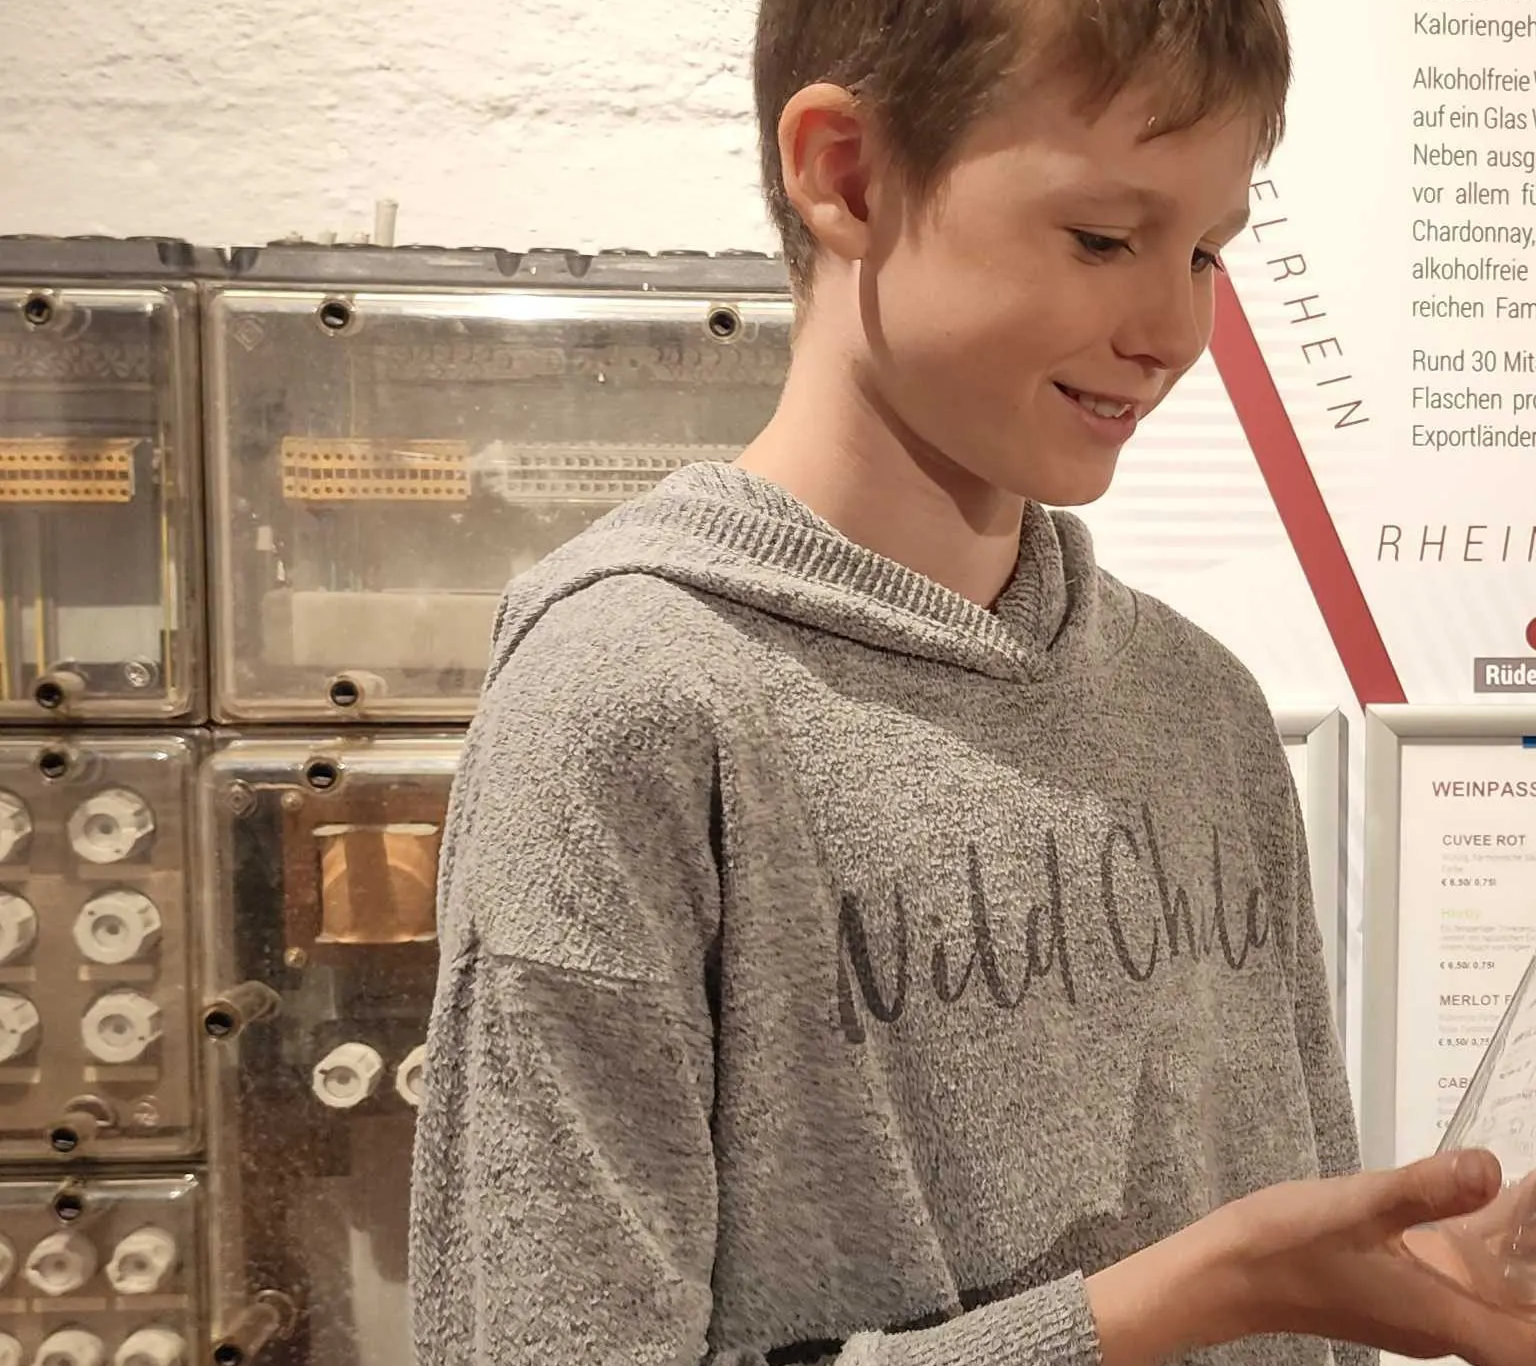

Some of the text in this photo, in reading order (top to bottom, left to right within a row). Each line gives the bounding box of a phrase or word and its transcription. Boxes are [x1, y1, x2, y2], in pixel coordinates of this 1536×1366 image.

[1412, 142, 1478, 167] Neben
[1412, 218, 1536, 250] Chardonnay,
[1411, 255, 1529, 282] alkoholfreie
[1249, 179, 1371, 431] ELRHEIN
[1412, 293, 1485, 319] reichen
[1412, 348, 1465, 372] Rund
[1471, 349, 1497, 373] 30
[1442, 834, 1527, 847] CUVEE ROT
[1439, 995, 1500, 1007] MERLOT
